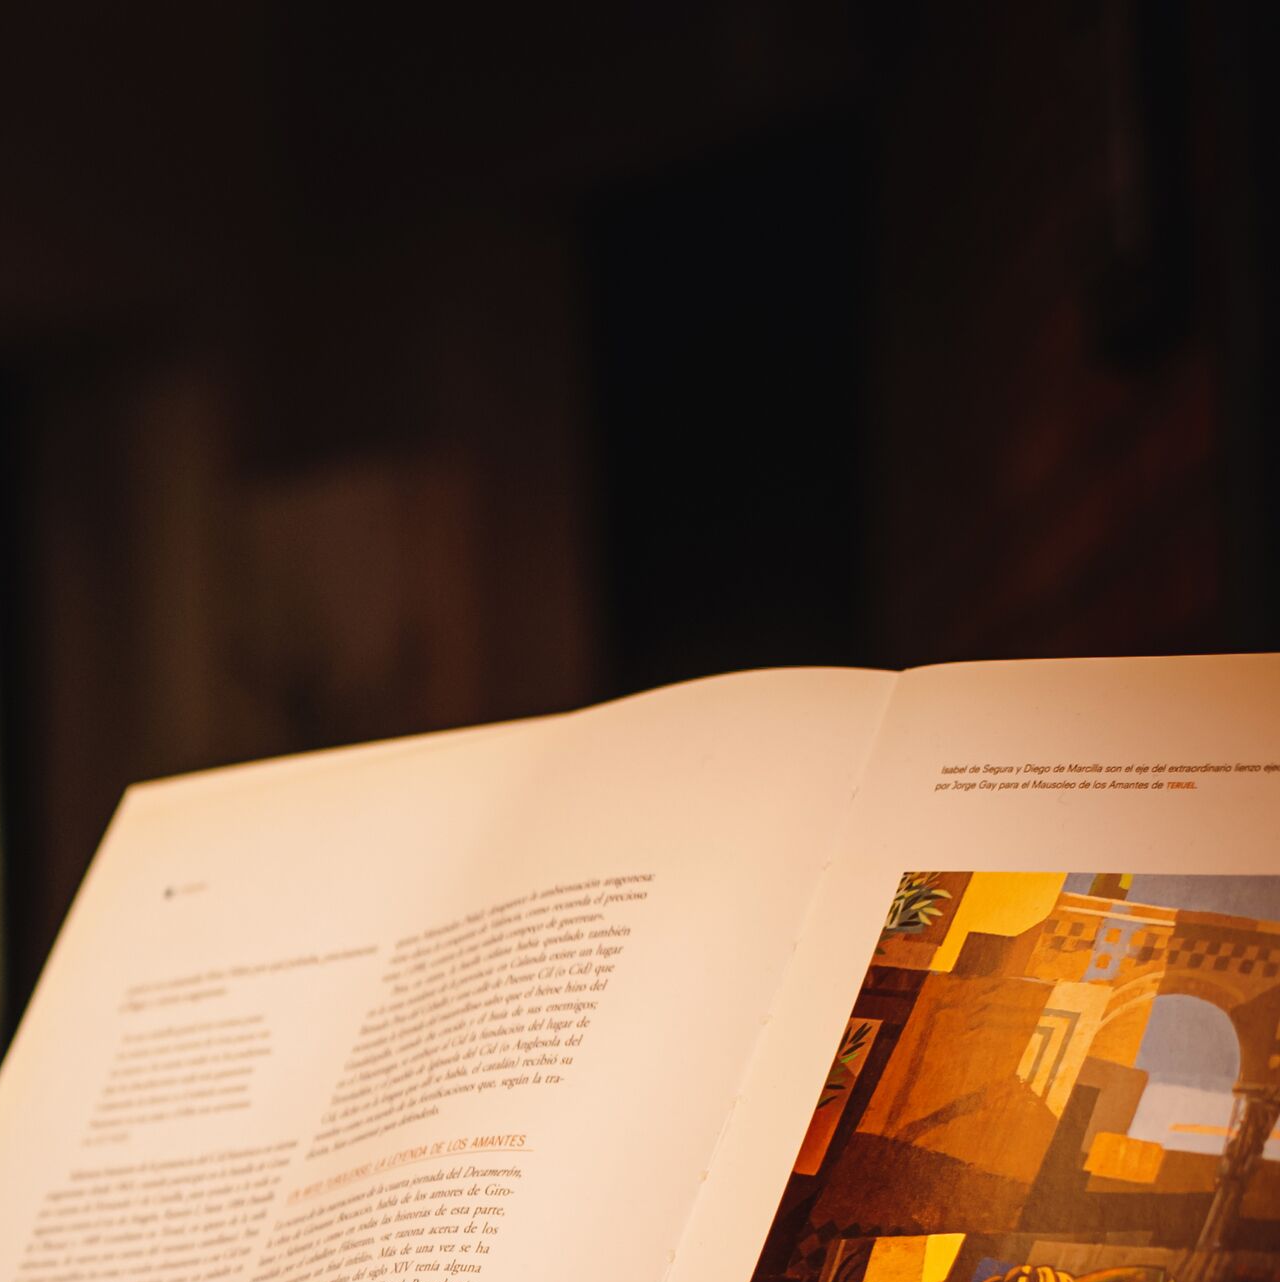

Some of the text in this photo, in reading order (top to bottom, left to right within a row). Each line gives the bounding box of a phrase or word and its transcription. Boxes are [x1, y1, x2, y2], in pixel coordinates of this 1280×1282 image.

[471, 1134, 526, 1149] AMANTES
[472, 1206, 505, 1219] parte,
[464, 1220, 498, 1235] de los
[459, 1241, 490, 1254] se ha
[444, 1258, 482, 1276] alguna
